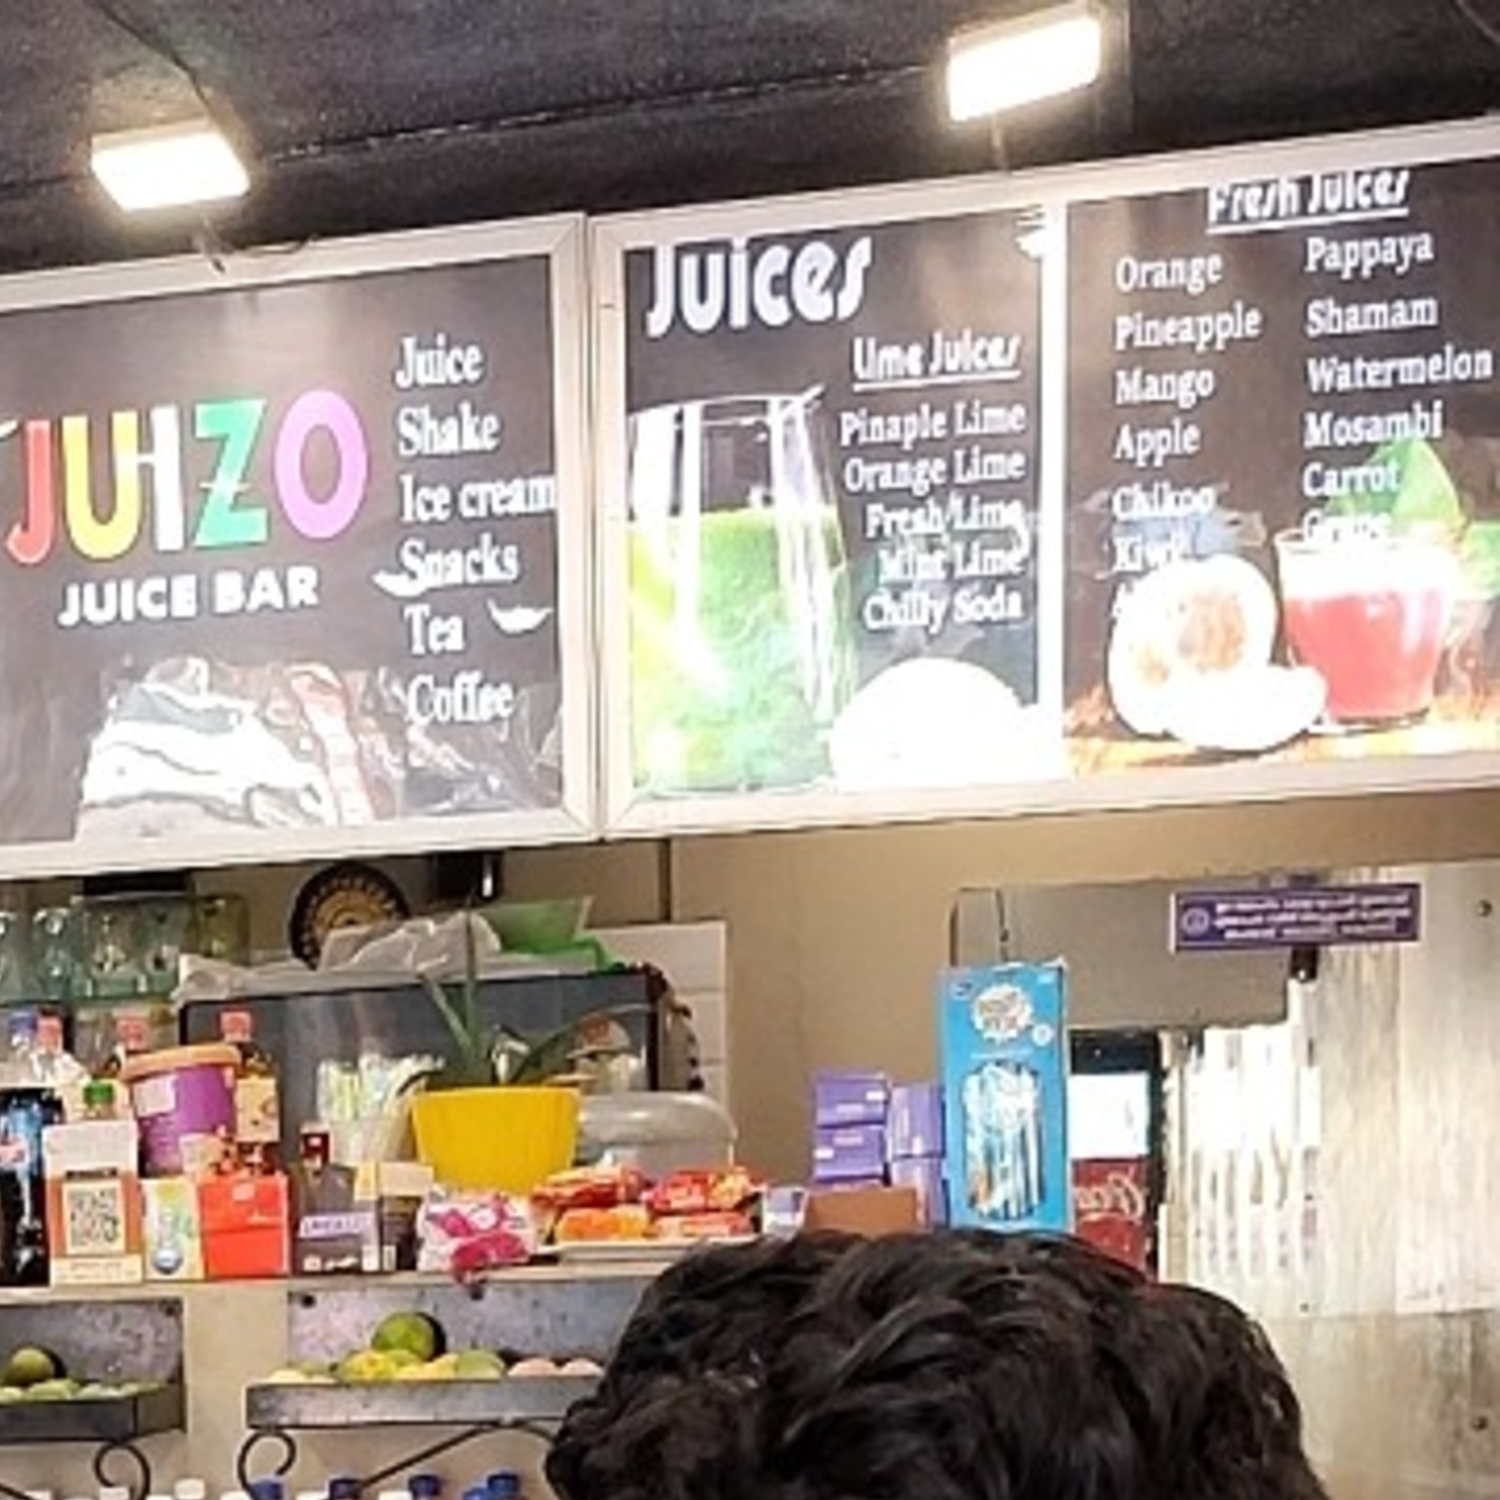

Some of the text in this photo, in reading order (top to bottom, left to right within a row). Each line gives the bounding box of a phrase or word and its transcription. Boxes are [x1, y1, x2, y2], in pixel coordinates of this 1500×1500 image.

[1208, 168, 1410, 224] Fresh Juices
[1116, 252, 1222, 295] Orange
[1305, 233, 1434, 280] Pappaya
[646, 236, 872, 338] Juices
[1115, 301, 1263, 352] Pineapple
[1306, 296, 1438, 337] Shamam
[395, 333, 483, 388] Juice
[929, 328, 1021, 374] Juices
[1307, 343, 1493, 393] Watermelon
[1115, 367, 1214, 408] Mango
[398, 402, 500, 456] Shake
[840, 400, 1026, 450] Pinaple Lime
[1113, 416, 1201, 467] Apple
[1304, 399, 1443, 448] Mosambi
[5, 388, 368, 564] JUIZO
[844, 446, 1026, 498] Orange Lime
[1303, 459, 1400, 498] Carrot
[400, 474, 556, 523] Ice cream
[866, 499, 944, 539] Fresh
[402, 533, 519, 586] Snacks
[954, 541, 1025, 578] Lime
[58, 566, 319, 627] JUICE BAR
[863, 583, 1023, 636] Chilly Soda
[404, 603, 465, 655] Tea
[407, 671, 515, 724] Coffee
